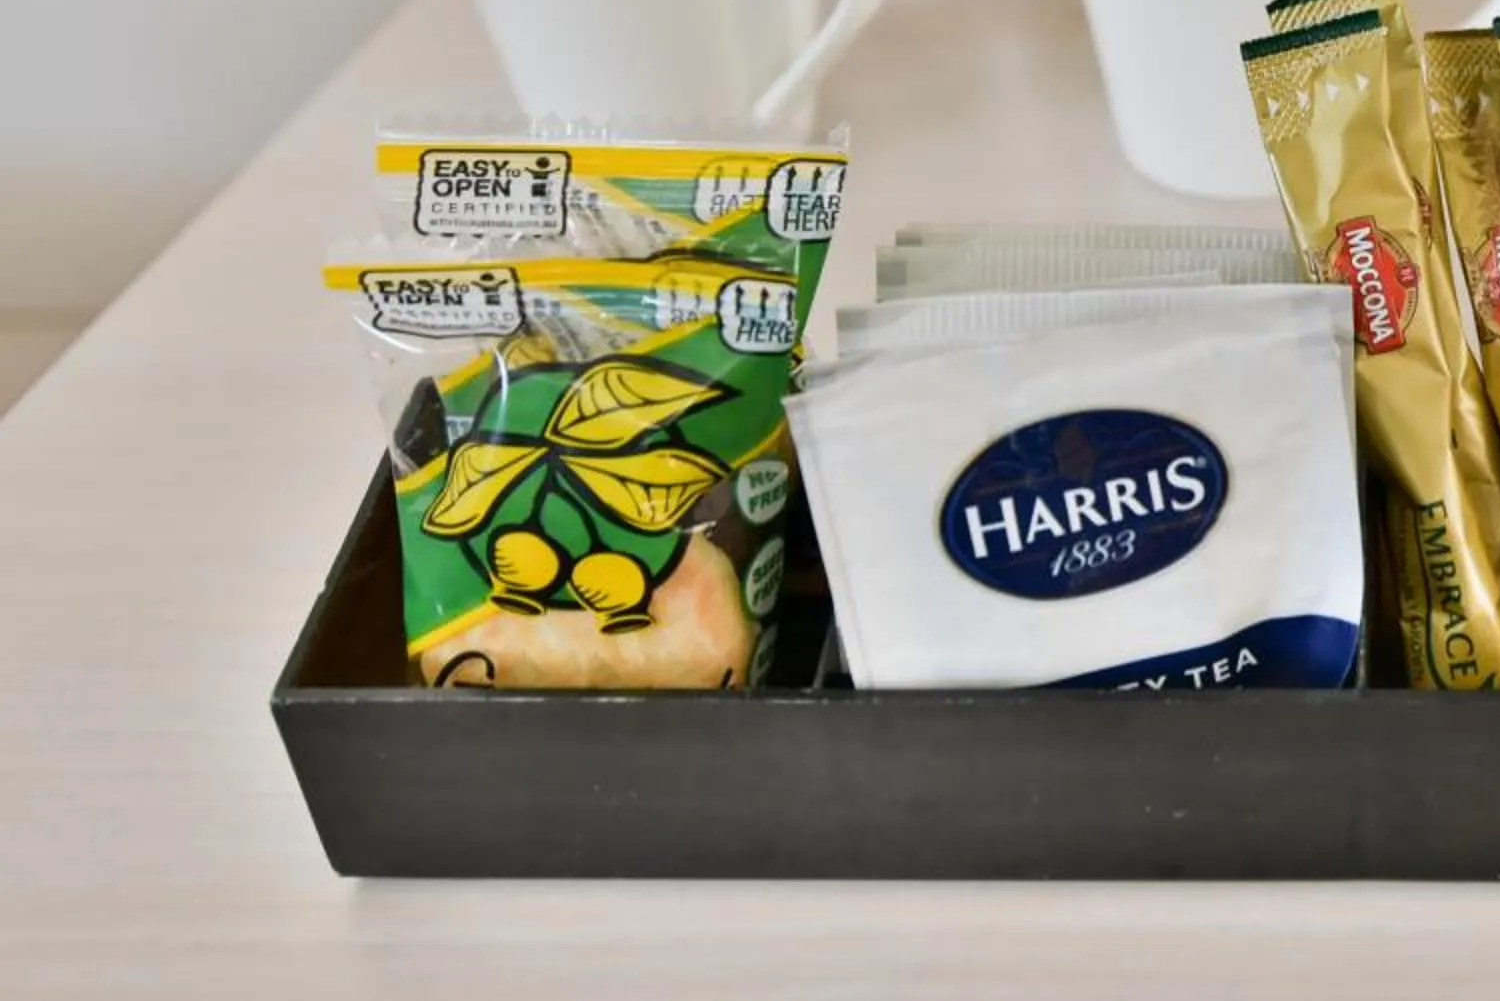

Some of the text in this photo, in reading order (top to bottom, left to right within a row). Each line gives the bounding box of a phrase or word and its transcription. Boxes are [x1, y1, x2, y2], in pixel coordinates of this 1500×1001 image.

[432, 179, 511, 198] OPEN
[434, 160, 509, 177] EASY
[431, 202, 557, 215] CERTIFIED
[783, 193, 841, 211] TEAR
[1346, 226, 1395, 345] MOCCONA
[965, 456, 1206, 559] HARRIS
[1050, 529, 1136, 577] 1883
[1416, 499, 1478, 680] EMBRACE
[1184, 647, 1258, 690] TEA
